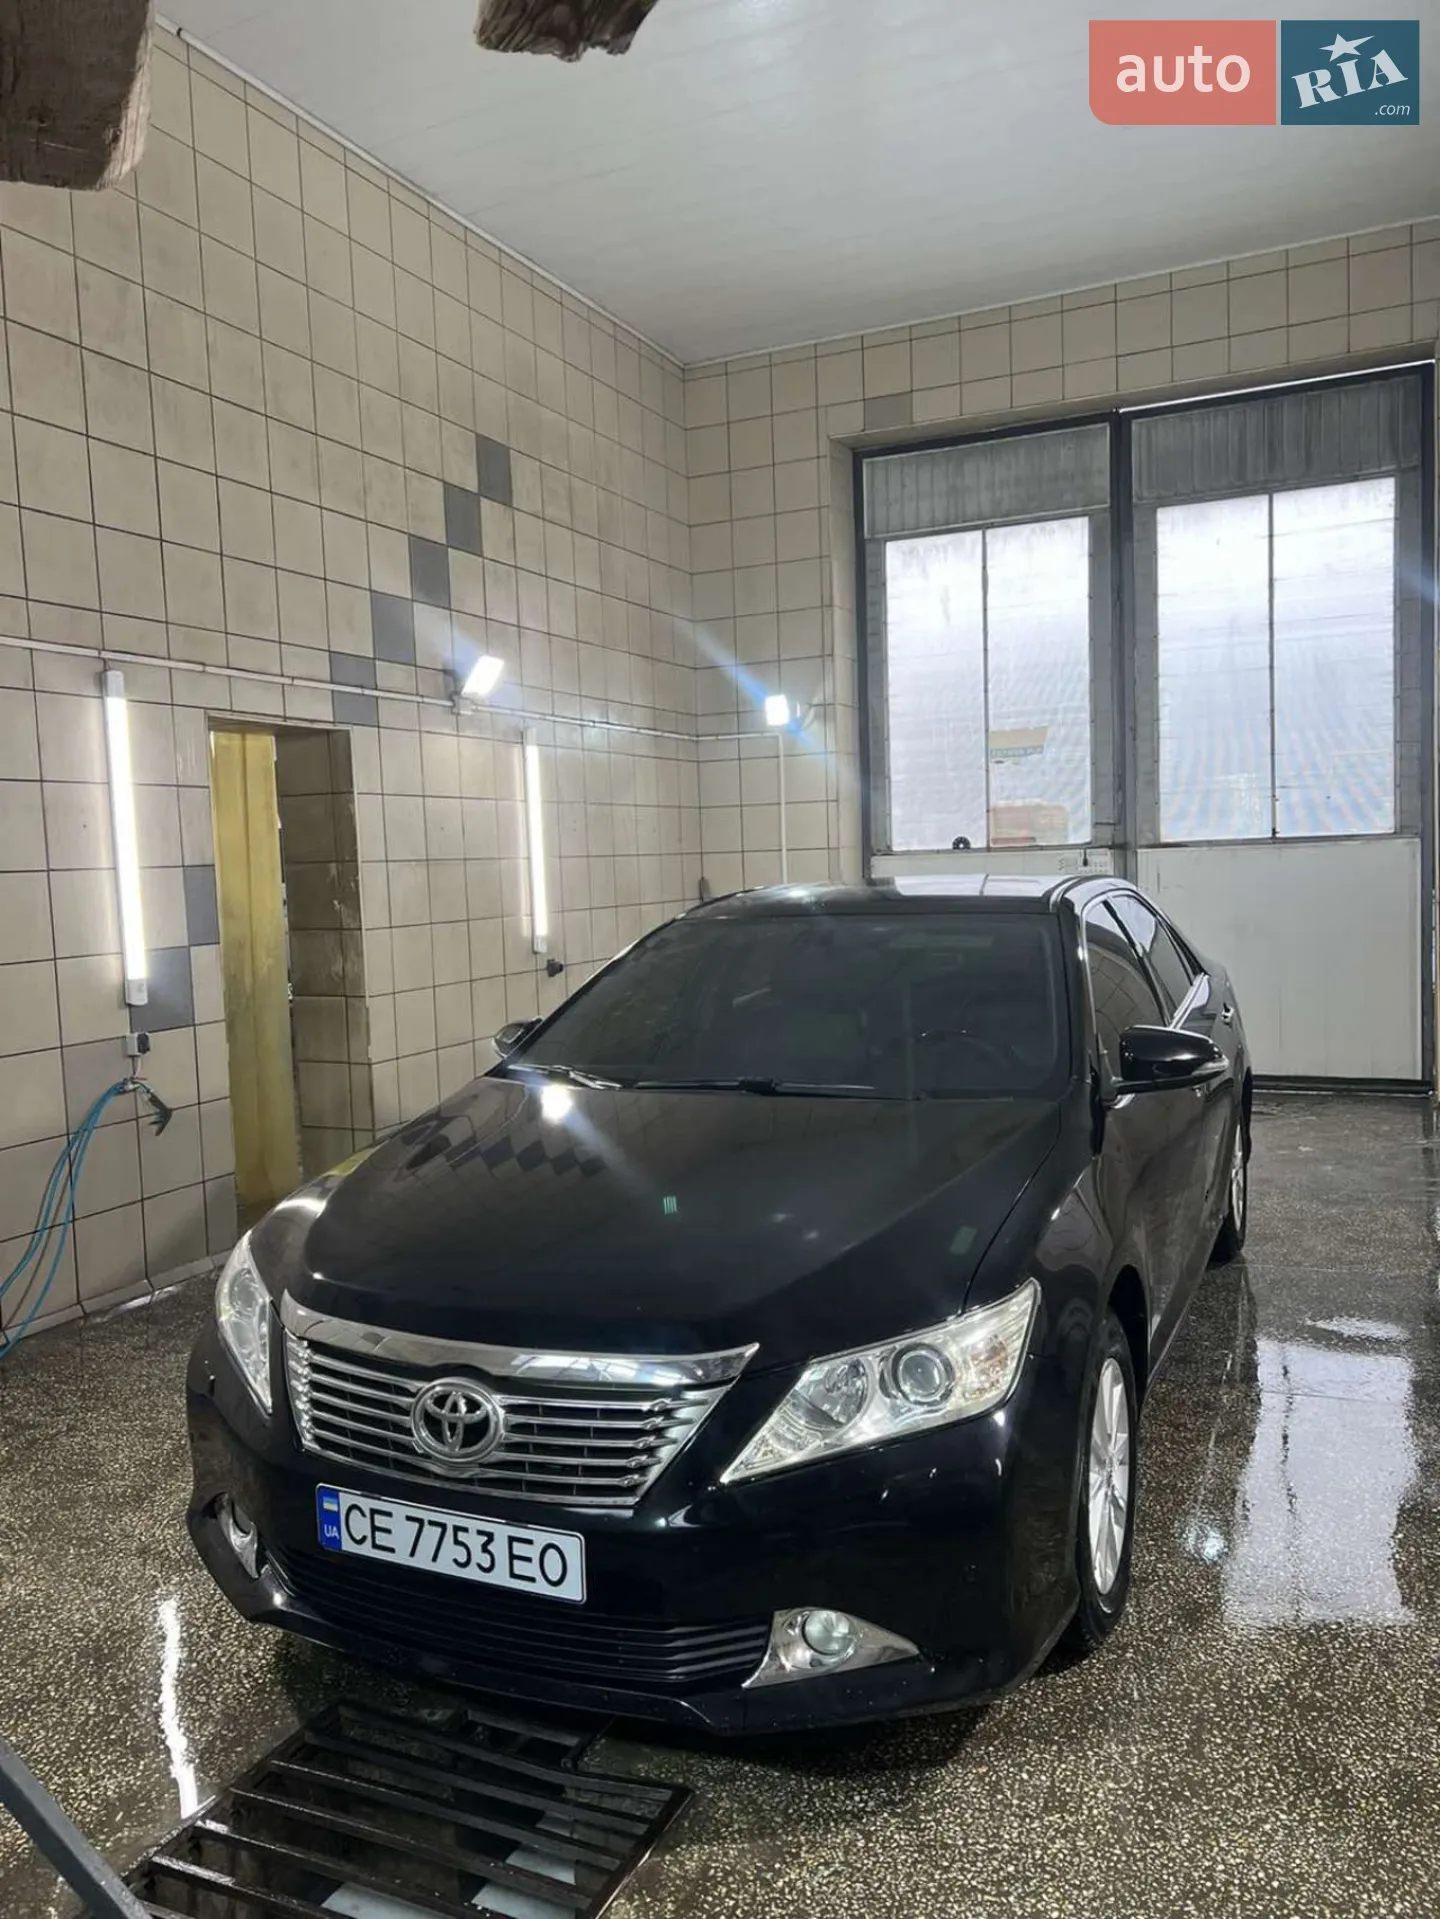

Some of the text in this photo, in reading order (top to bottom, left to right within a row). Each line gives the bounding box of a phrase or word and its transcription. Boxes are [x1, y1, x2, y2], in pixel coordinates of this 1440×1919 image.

[323, 1523, 340, 1539] UA
[344, 1503, 568, 1588] CE 7753 EO
